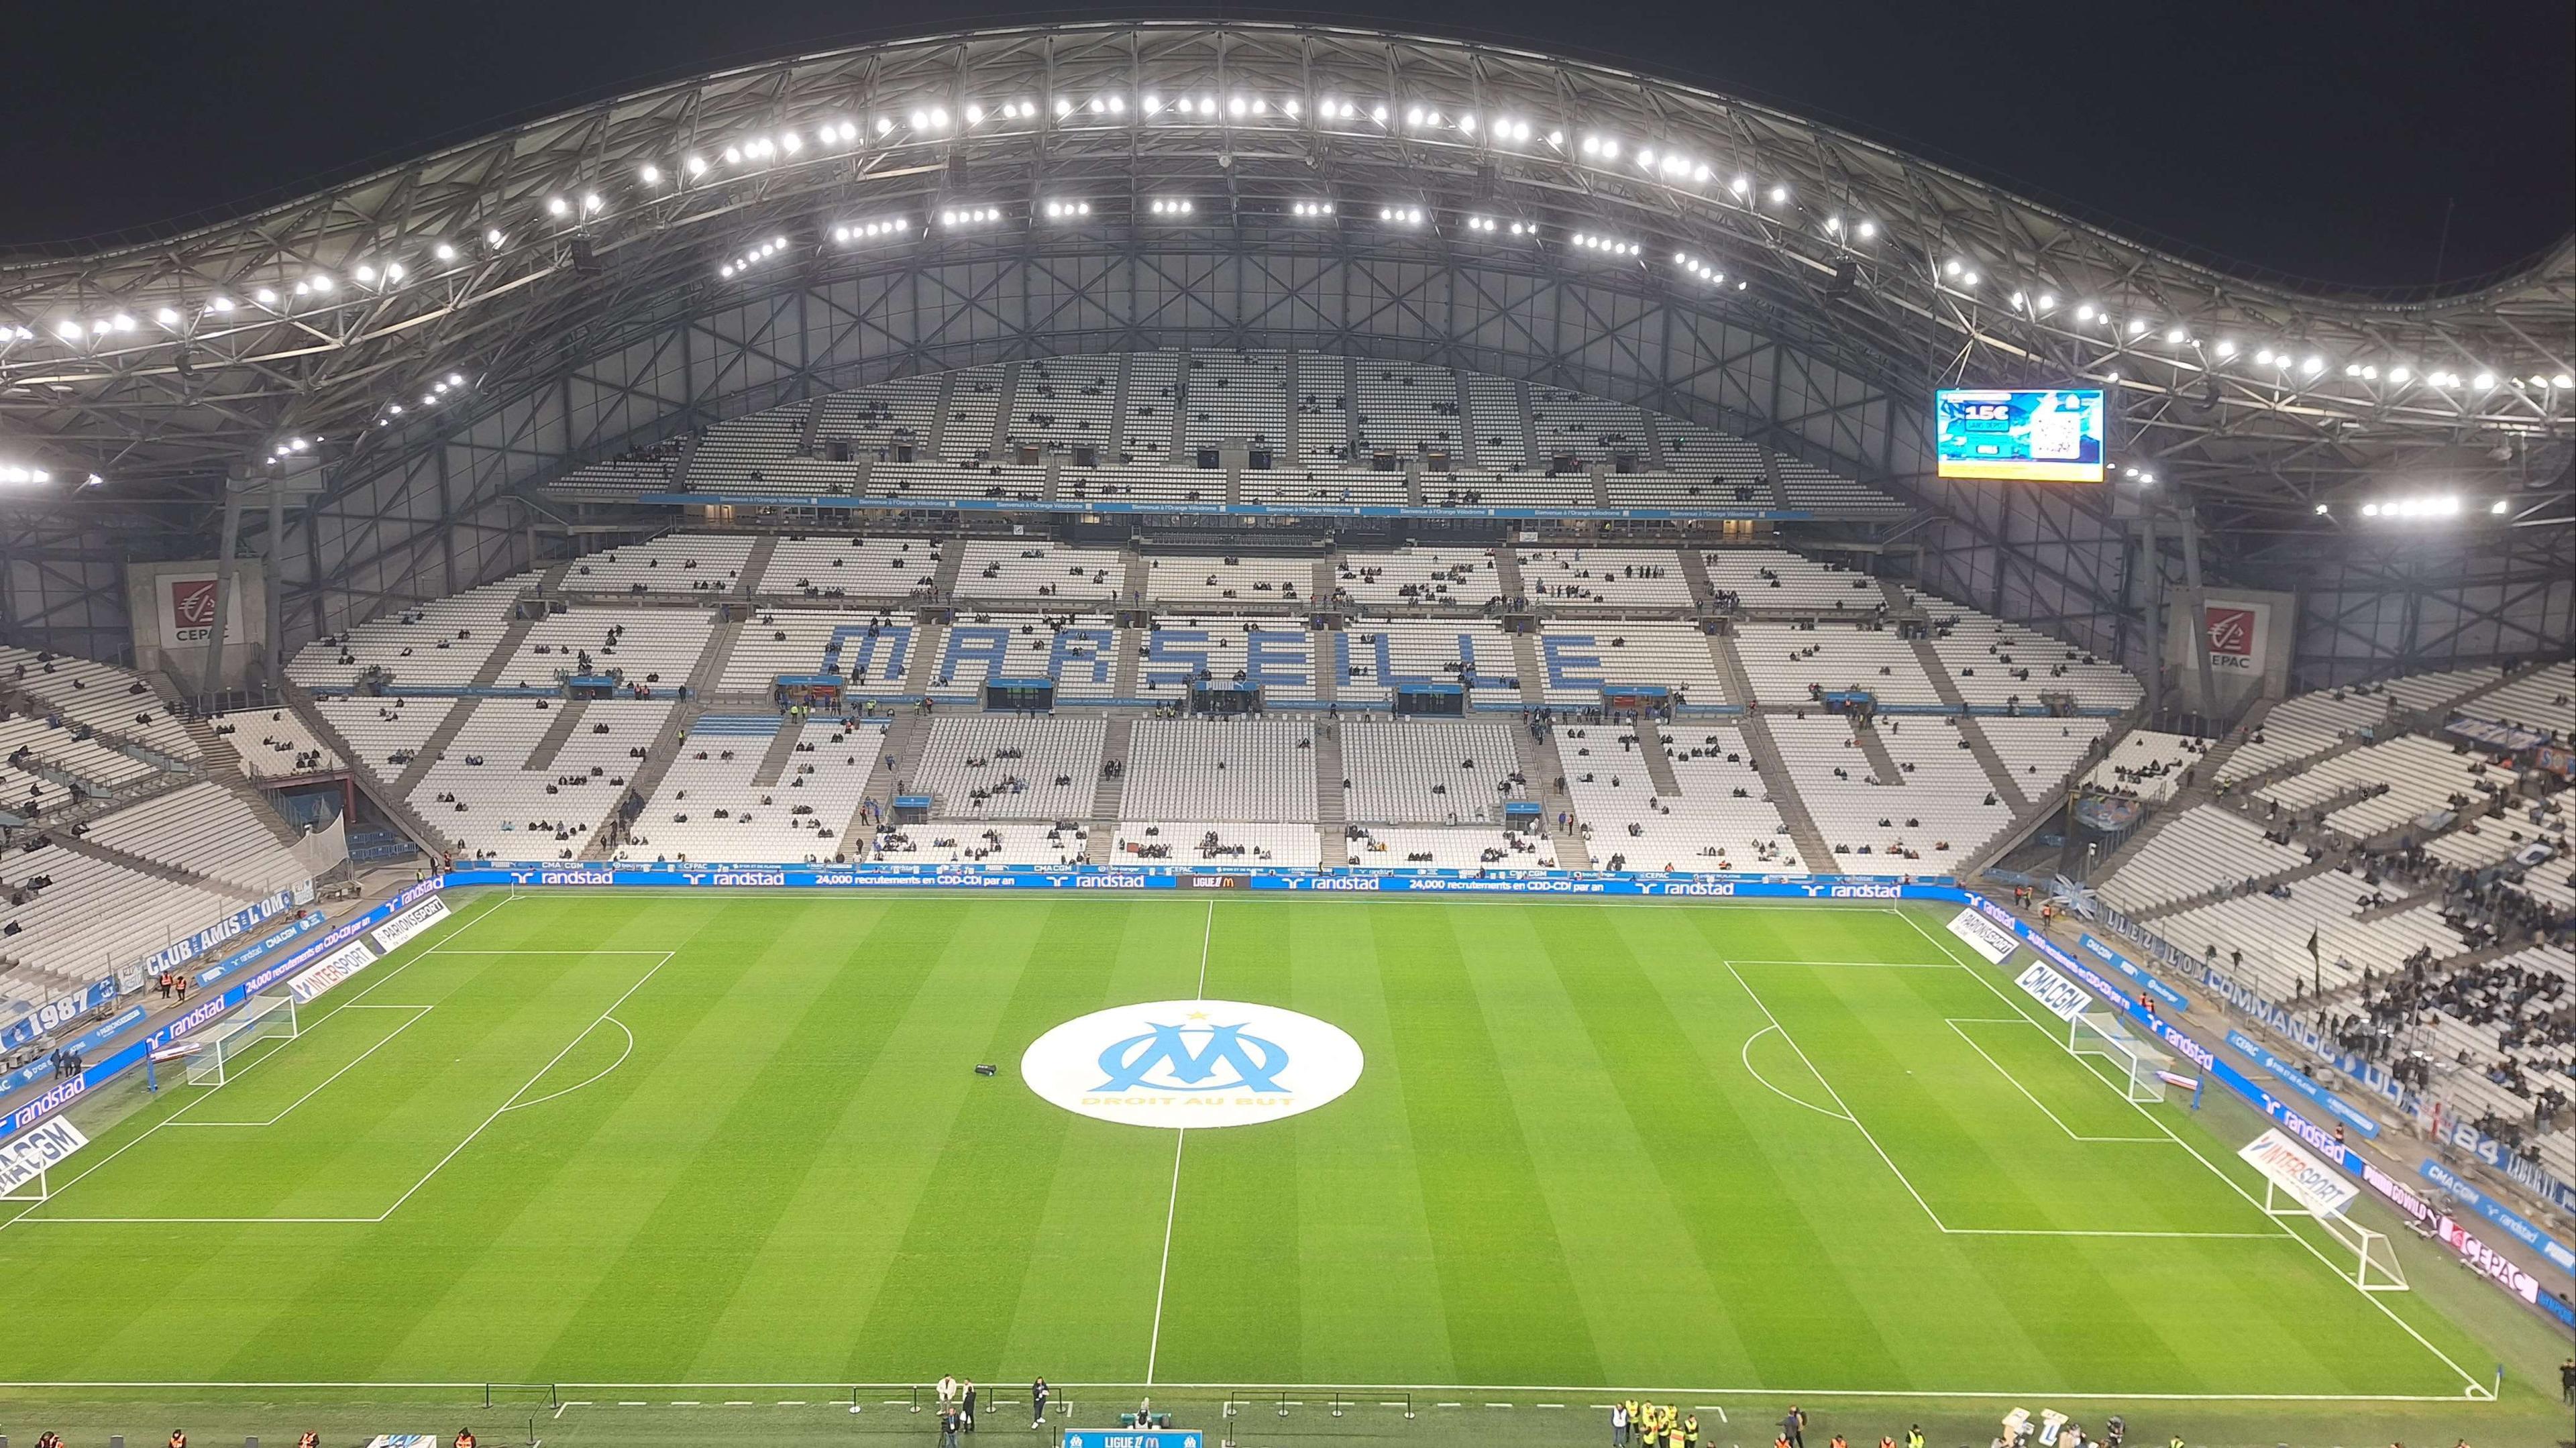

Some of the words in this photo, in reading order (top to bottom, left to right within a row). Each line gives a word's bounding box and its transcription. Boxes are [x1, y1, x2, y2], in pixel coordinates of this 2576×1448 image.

[176, 624, 229, 642] CEP
[2211, 655, 2250, 669] EPAC
[402, 875, 444, 905] randstad
[541, 871, 614, 885] randstad
[713, 872, 785, 885] randstad
[815, 875, 853, 885] 24,000
[855, 875, 921, 885] recrutements
[937, 875, 981, 885] CDD-CDI
[983, 877, 1001, 887] par
[1002, 877, 1015, 886] an
[1076, 875, 1144, 888] randstad
[1311, 877, 1379, 891] randstad
[1409, 879, 1446, 890] 24,000
[1448, 880, 1511, 891] recrutements
[1513, 883, 1526, 891] en
[1527, 881, 1572, 891] CDD-CDI
[1574, 883, 1590, 893] par
[1591, 883, 1604, 892] an
[1664, 883, 1734, 896] randstad
[1831, 885, 1902, 898] randstad
[1984, 901, 2016, 931] randstad
[2107, 910, 2153, 949] LLEZ
[146, 940, 193, 977] CLUB
[201, 915, 241, 950] AMIS
[246, 970, 272, 993] 24,000
[314, 942, 325, 954] en
[350, 922, 361, 938] par
[360, 917, 370, 930] an
[304, 946, 370, 994] INTERSPORT
[29, 988, 88, 1036] 1987
[170, 995, 225, 1040] randstad
[2165, 1027, 2214, 1072] randstad
[15, 1073, 85, 1129] randstad
[1081, 1097, 1177, 1106] DROIT
[1183, 1097, 1225, 1106] AU
[1234, 1098, 1295, 1107] BUT
[2284, 1110, 2347, 1166] randstad
[2453, 1124, 2500, 1166] 84
[2428, 1166, 2454, 1188] CMA
[2465, 1237, 2527, 1292] CEPAC
[1105, 1436, 1134, 1448] LIGUE
